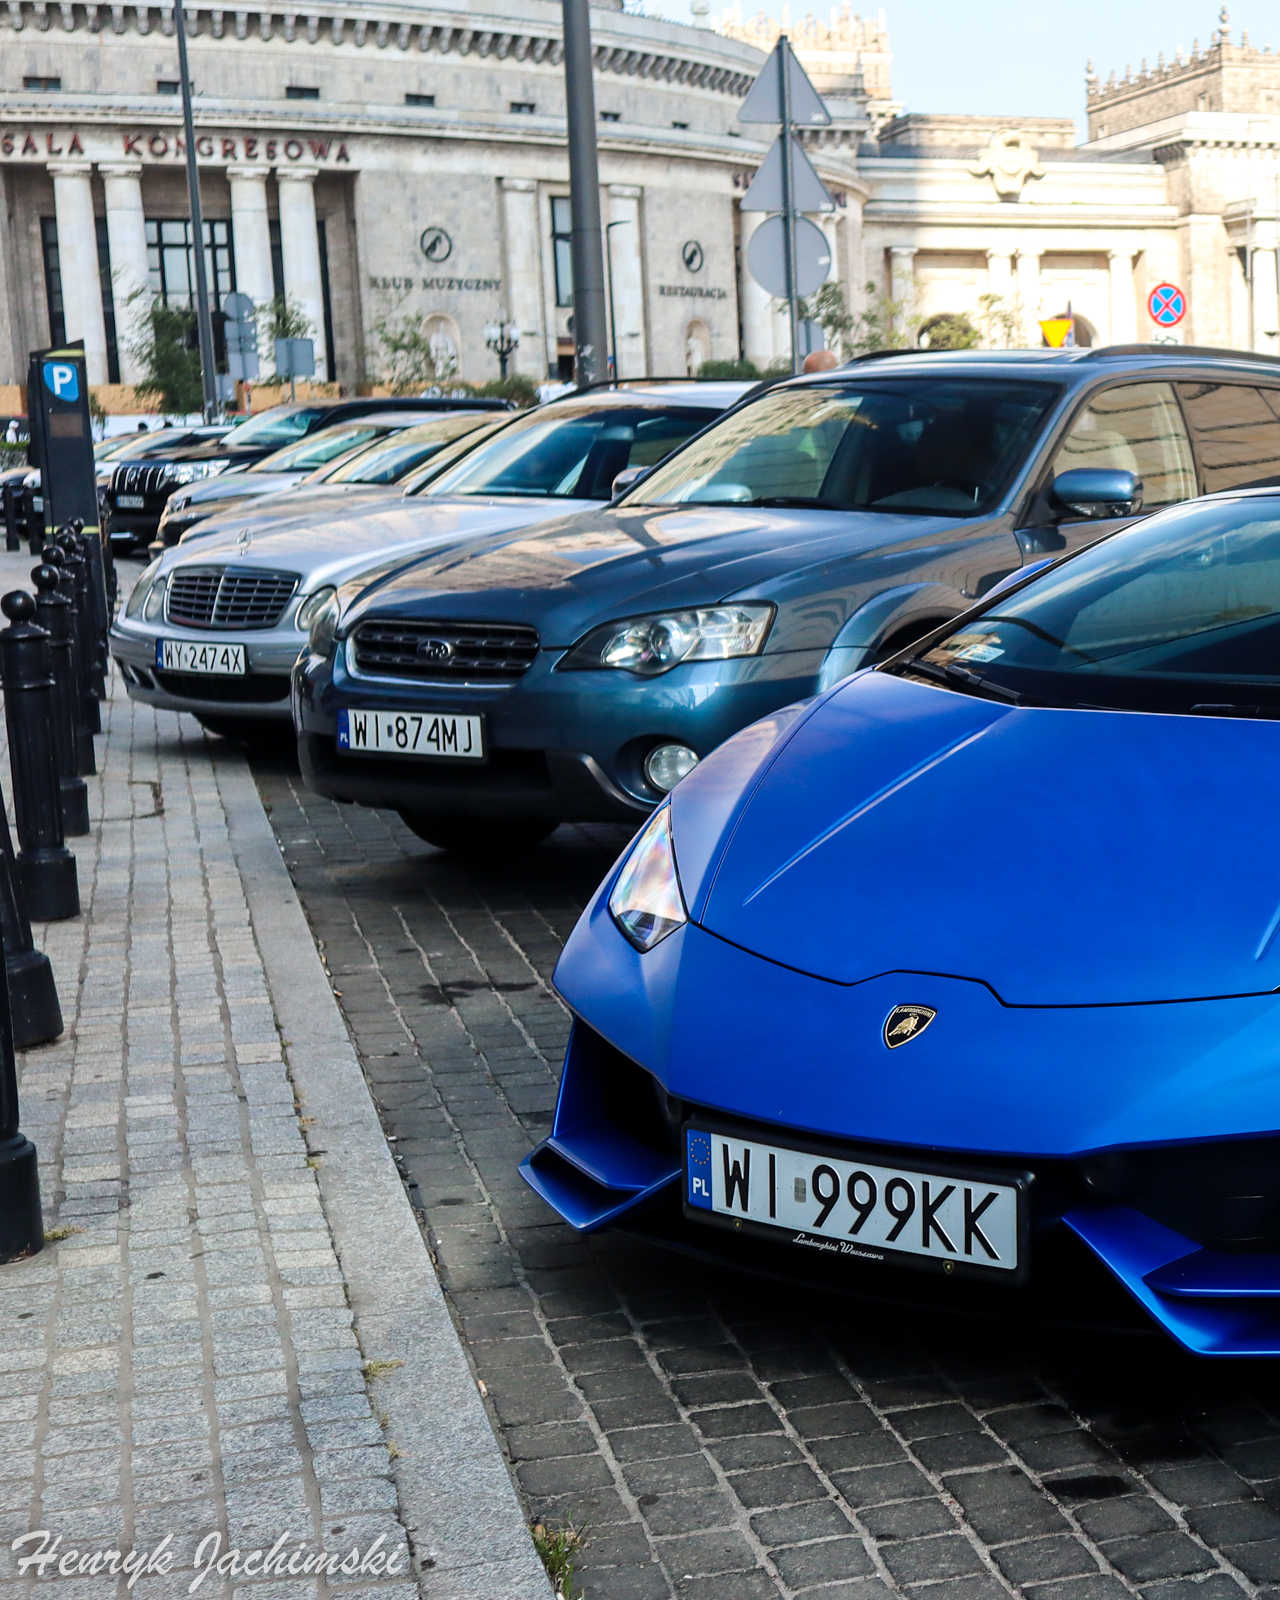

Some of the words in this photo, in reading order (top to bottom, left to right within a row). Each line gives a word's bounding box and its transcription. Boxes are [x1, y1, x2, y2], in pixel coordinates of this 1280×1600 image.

[1, 132, 86, 156] SALA
[122, 133, 352, 163] KONGRESOWA
[368, 276, 414, 290] KLUB
[422, 277, 502, 291] MUZYCZNY
[659, 285, 727, 300] RESTAURACJA
[52, 365, 73, 395] P
[164, 642, 183, 668] WY
[189, 645, 242, 673] 2474X
[340, 732, 348, 743] PL
[353, 713, 380, 748] WI
[395, 716, 473, 753] 874MJ
[692, 1177, 710, 1197] PL
[722, 1143, 777, 1219] WI
[811, 1163, 1001, 1261] 999KK
[792, 1232, 840, 1252] Lamborghini
[840, 1241, 885, 1260] Warszawa
